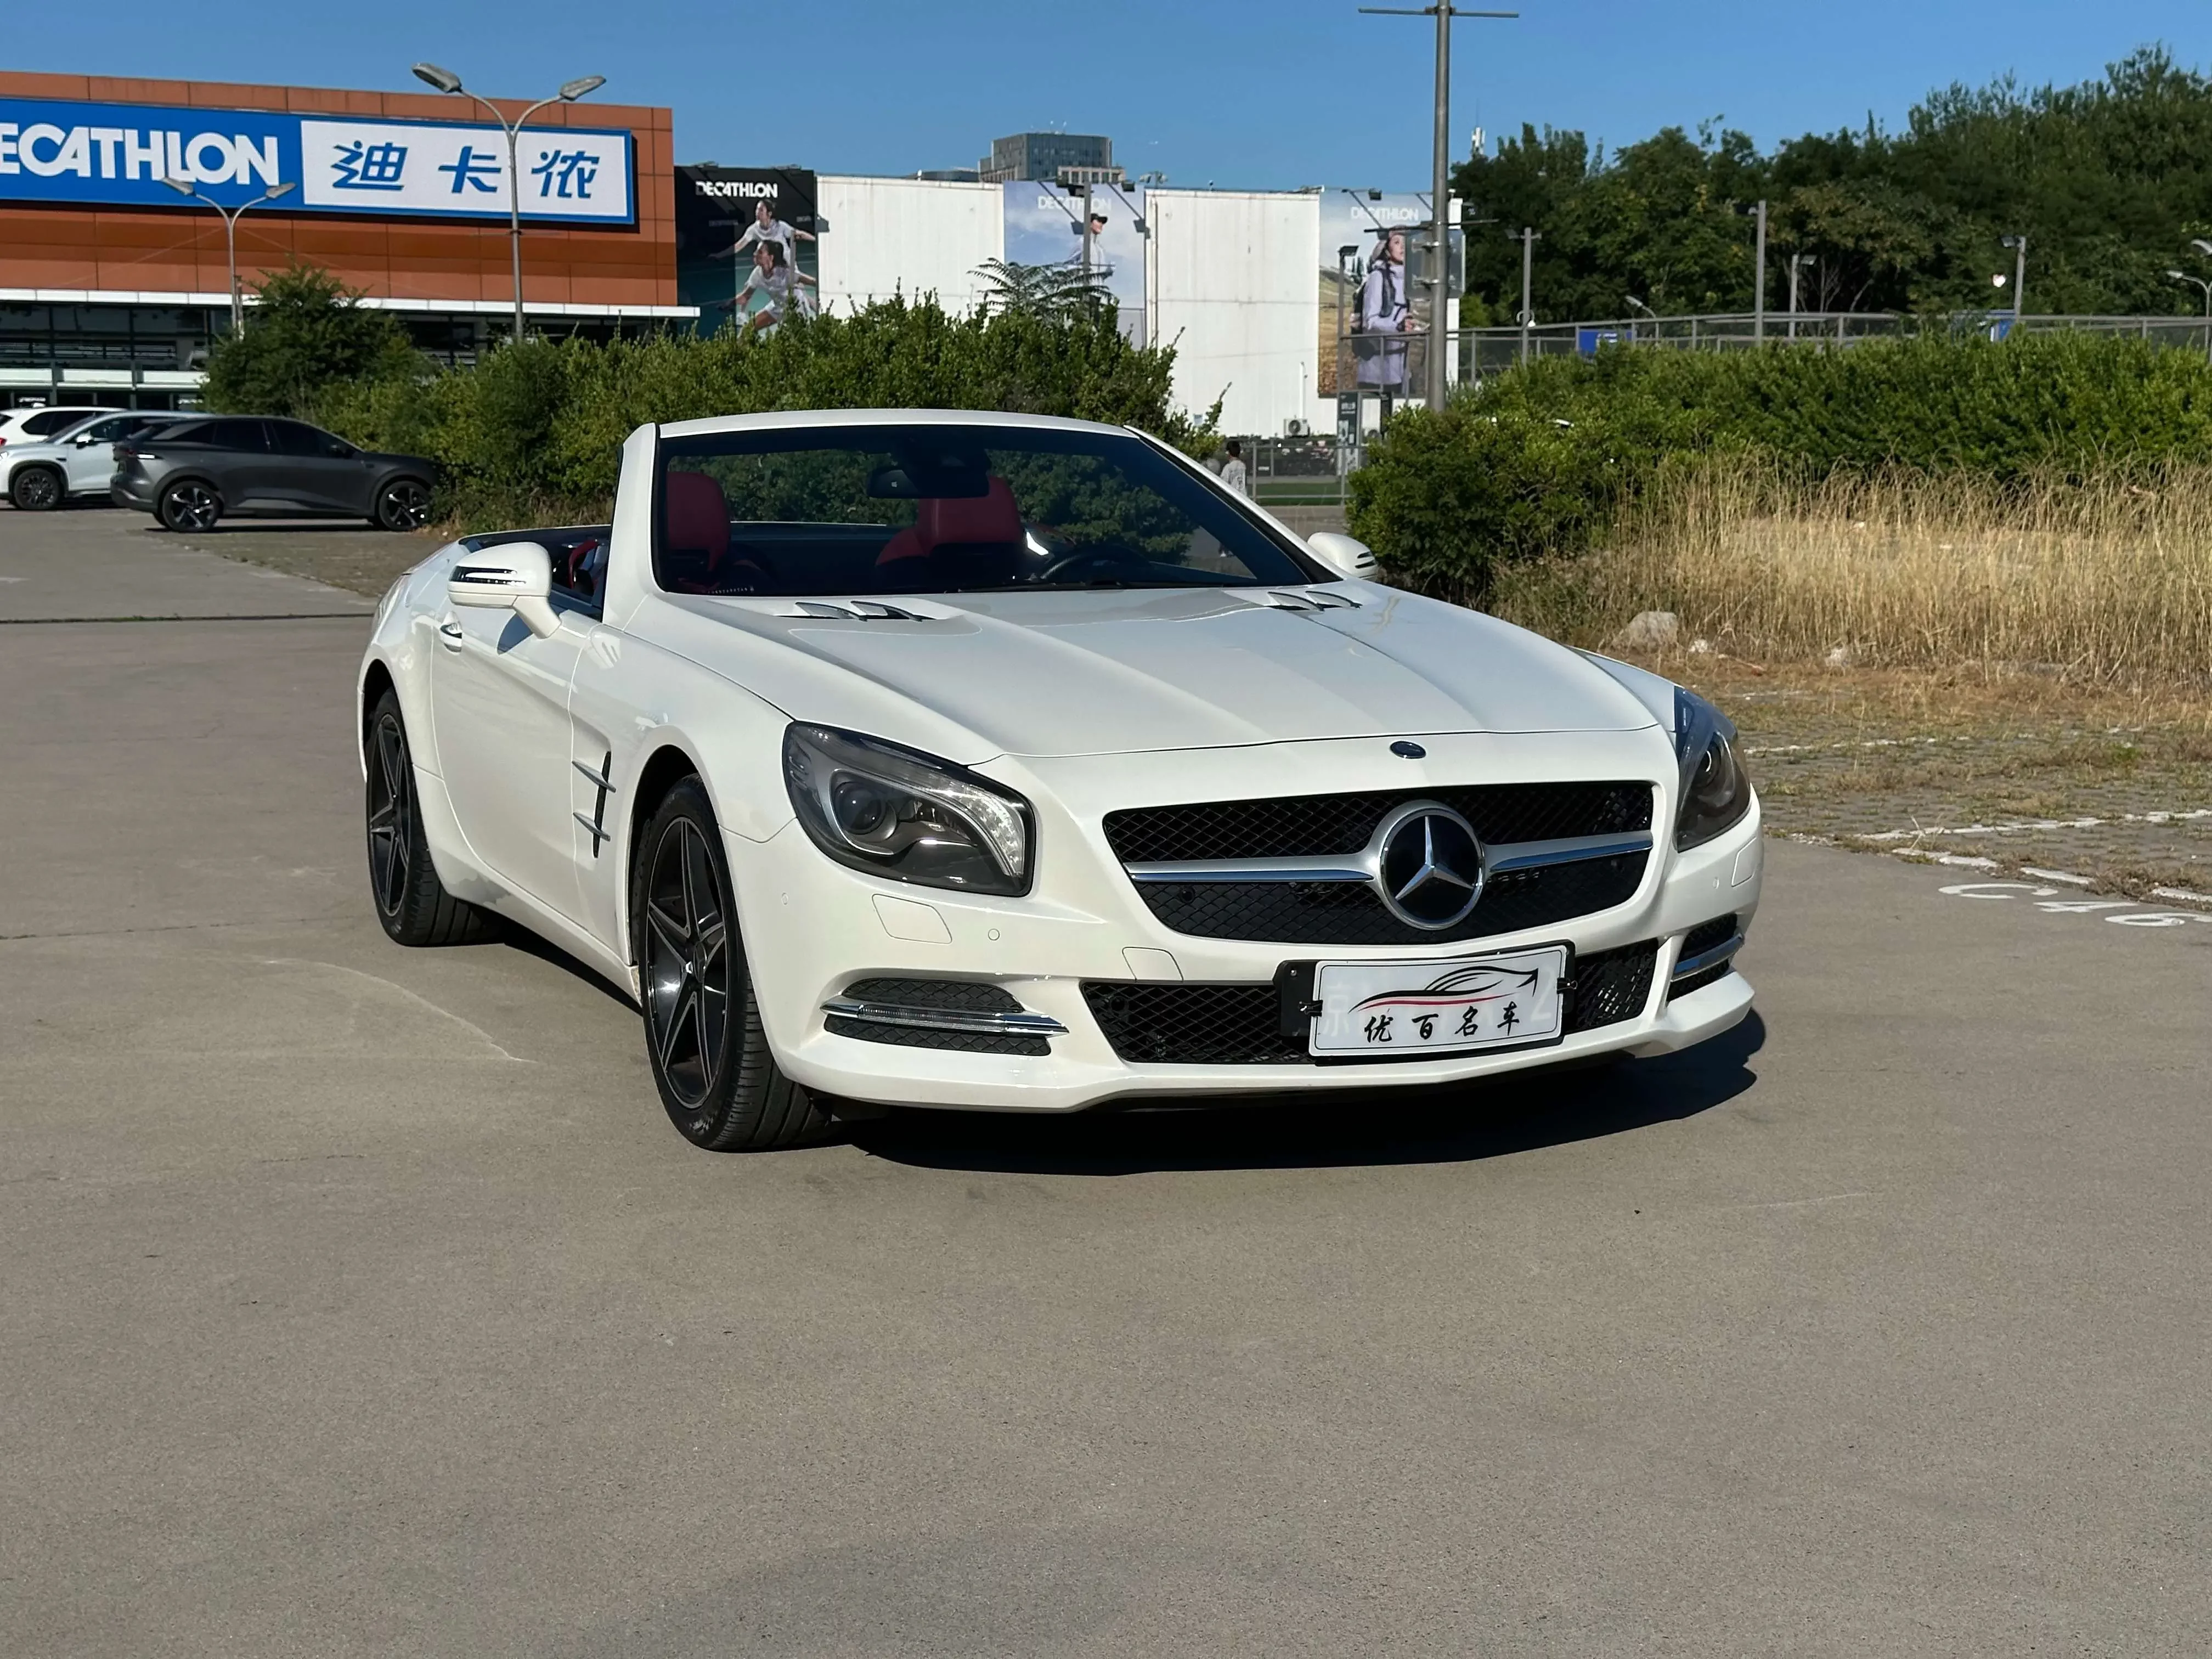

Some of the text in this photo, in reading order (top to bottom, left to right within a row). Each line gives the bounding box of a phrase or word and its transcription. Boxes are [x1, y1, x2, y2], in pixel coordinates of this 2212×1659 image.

[0, 122, 279, 187] ECATHLON
[331, 140, 600, 199] 迪卡侬
[695, 180, 778, 198] DECATHLON
[1938, 883, 2212, 927] C46
[1364, 1001, 1520, 1043] 优百名车
